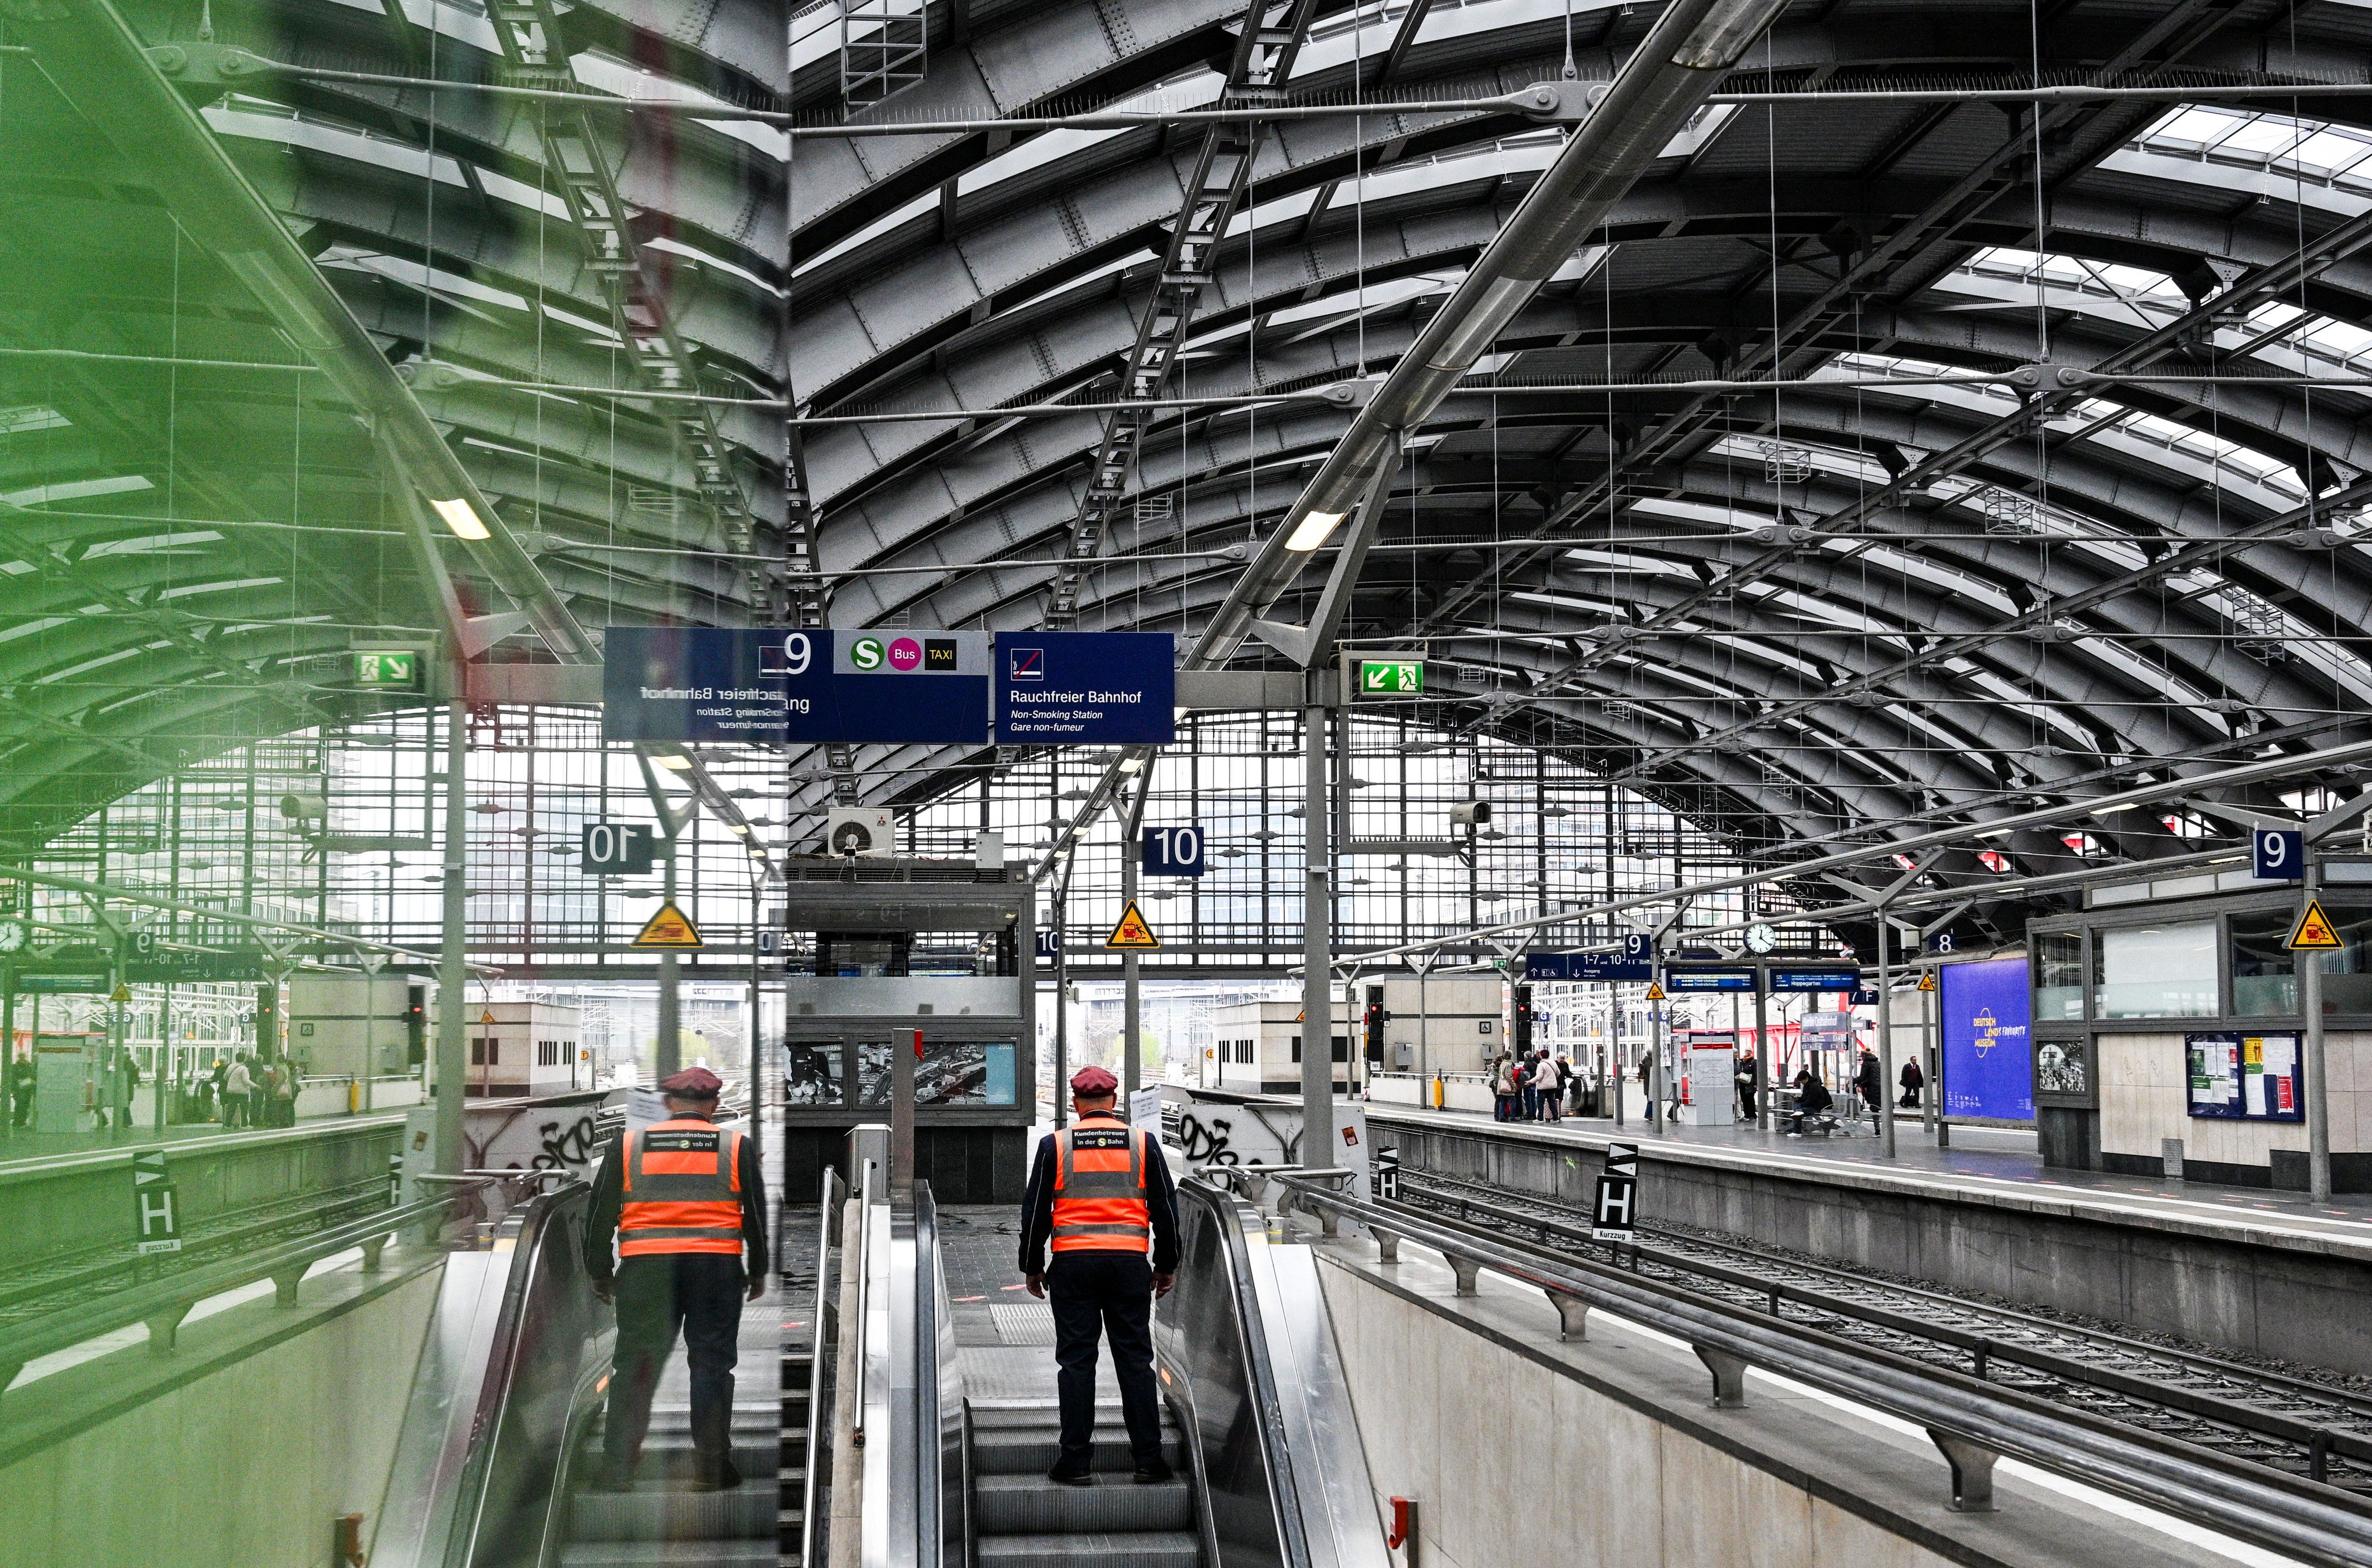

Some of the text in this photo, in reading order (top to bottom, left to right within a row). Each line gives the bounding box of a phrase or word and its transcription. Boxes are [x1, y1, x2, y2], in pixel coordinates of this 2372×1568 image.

[784, 633, 811, 675] 9
[856, 640, 953, 668] S Bus TAXI
[1010, 690, 1142, 703] Rauchfreier Bahnhof
[1010, 710, 1103, 720] Non-Smoking Station
[1010, 723, 1085, 732] Gare non-fumeur
[1154, 828, 1197, 864] 10
[2264, 832, 2285, 867] 9
[1038, 931, 1059, 951] 10
[1628, 935, 1641, 954] 9
[1939, 934, 1951, 953] 8
[1583, 955, 1599, 965] 1-7
[1865, 991, 1872, 1002] F
[1661, 1011, 1668, 1020] 6
[1803, 1017, 1814, 1027] Berlin
[1973, 1017, 1996, 1027] DEUTSCH
[1975, 1038, 1996, 1047] MUSEUM
[1381, 1173, 1396, 1198] H
[1600, 1182, 1631, 1224] H
[1599, 1230, 1626, 1241] Kurzzug
